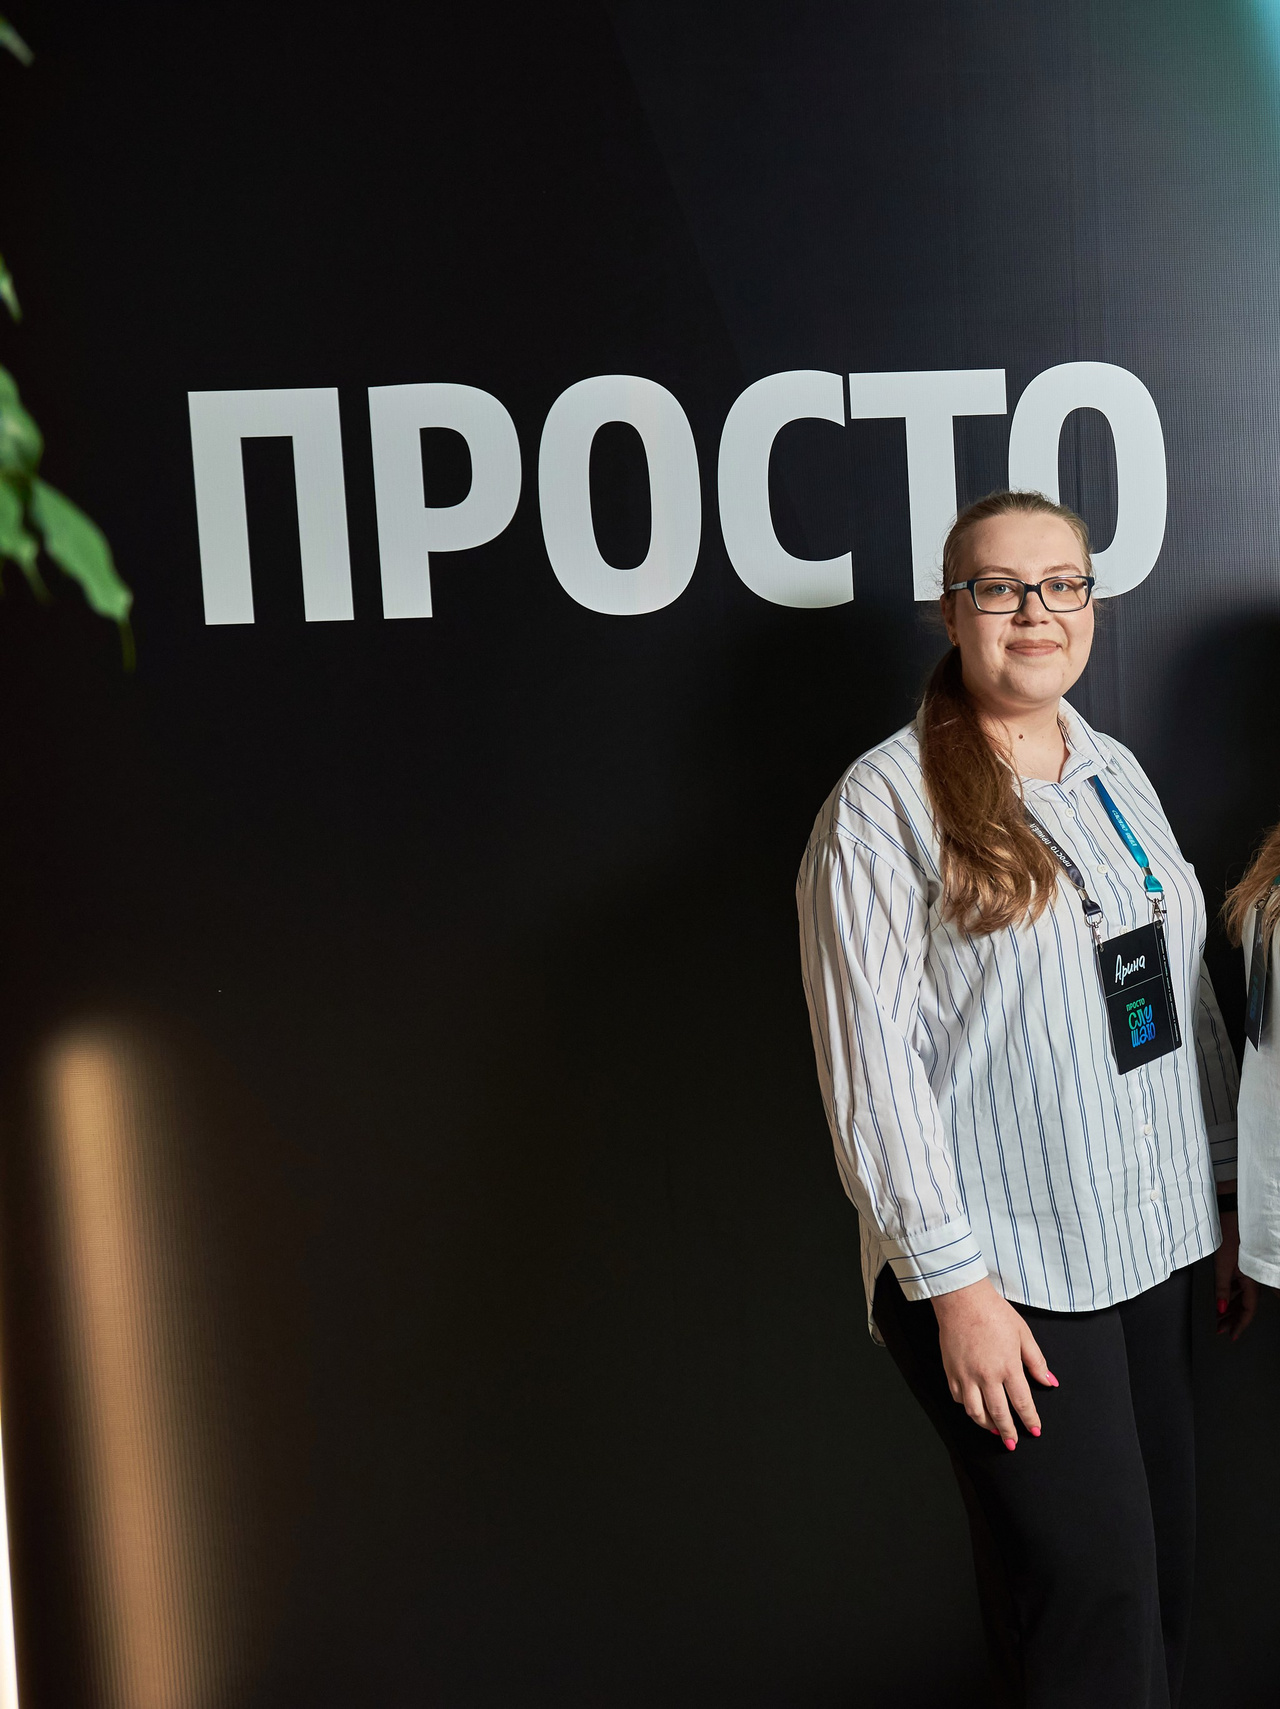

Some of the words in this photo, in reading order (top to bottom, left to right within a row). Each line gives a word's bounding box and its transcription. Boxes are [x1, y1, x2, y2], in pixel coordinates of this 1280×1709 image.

[188, 361, 1168, 626] ПРОСТО
[1050, 845, 1072, 867] ПРОСТО
[1115, 954, 1146, 986] Арина
[1126, 997, 1146, 1012] ПРОСТО
